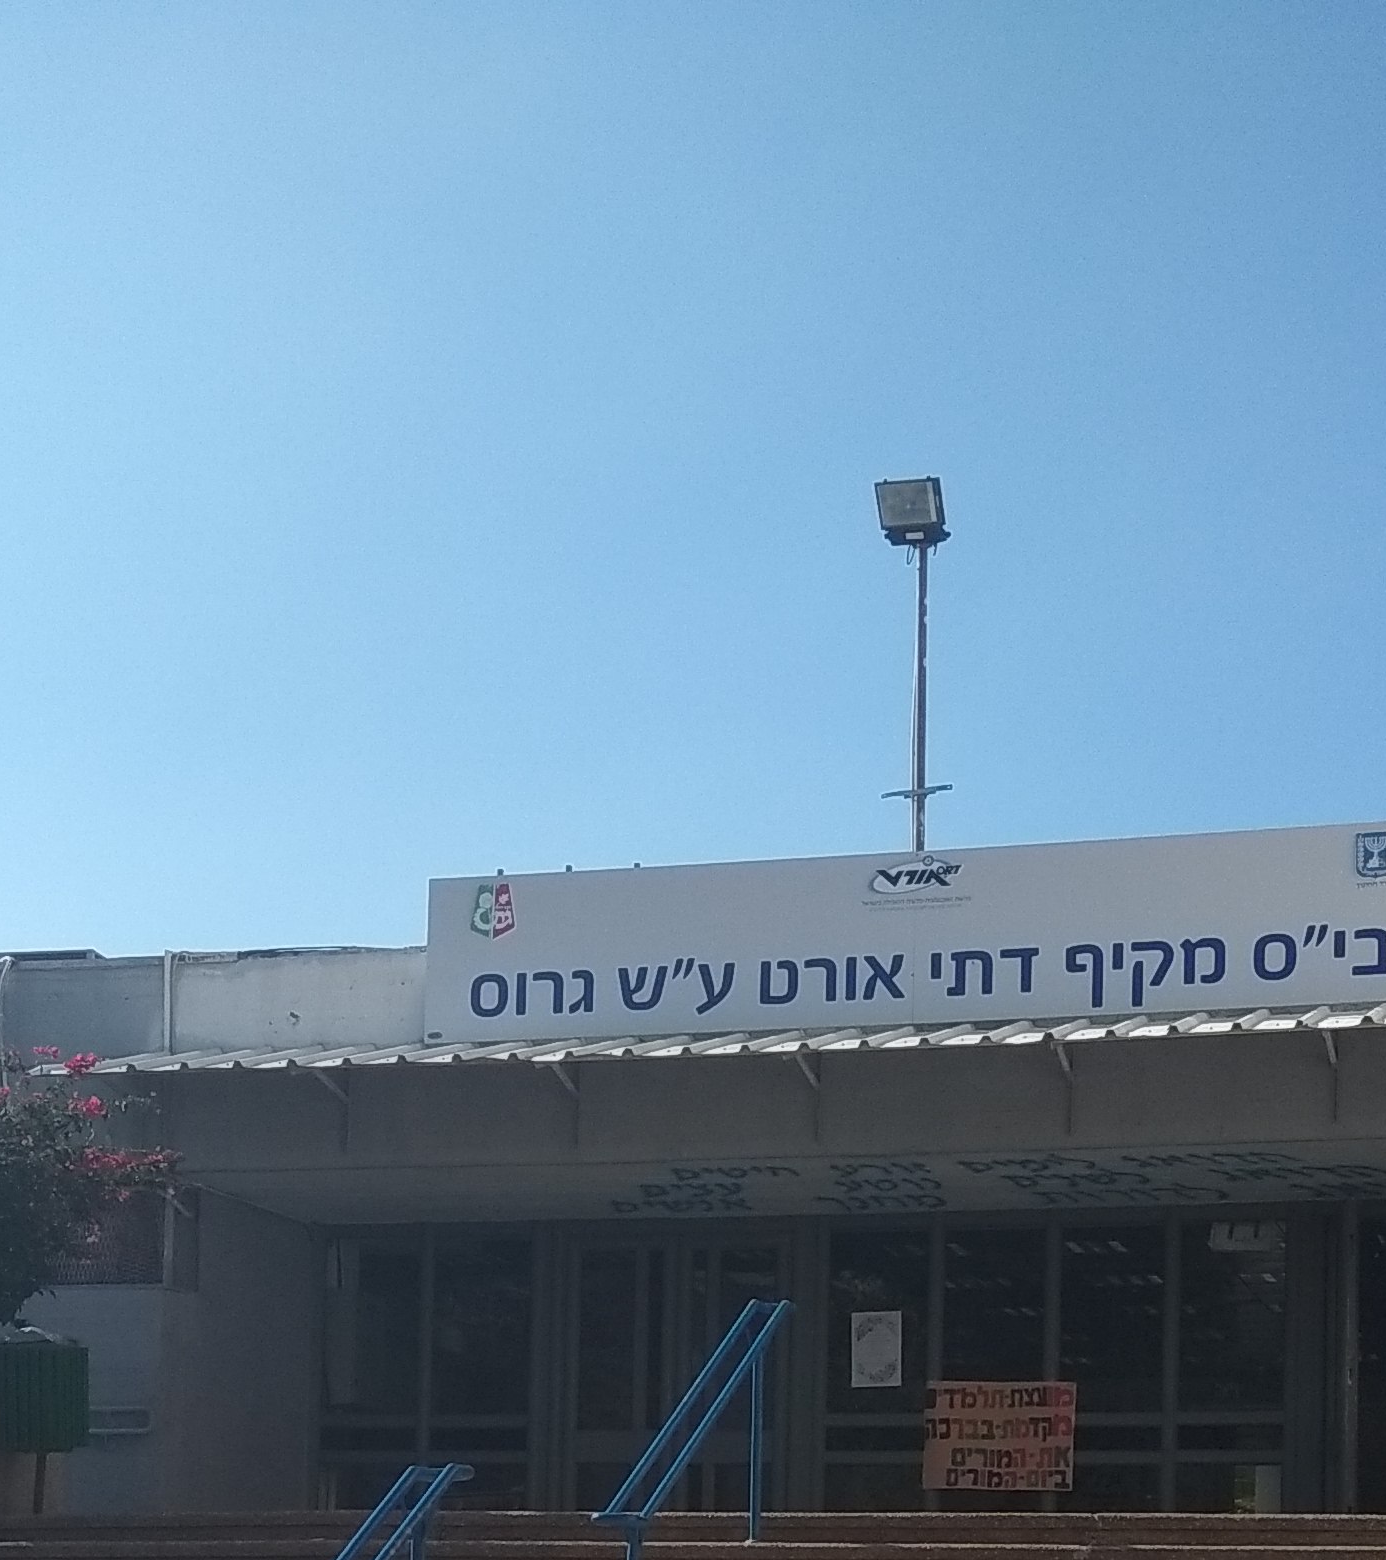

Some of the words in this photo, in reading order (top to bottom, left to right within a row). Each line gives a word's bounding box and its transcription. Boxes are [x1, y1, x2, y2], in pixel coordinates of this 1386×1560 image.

[936, 864, 961, 875] ORT
[760, 953, 906, 1005] אורט
[930, 947, 1040, 996] דתי
[1065, 937, 1226, 1008] מקיף
[471, 969, 595, 1018] גרוס
[617, 957, 736, 1015] ע"ש
[671, 1166, 800, 1181] חיטים
[830, 1162, 931, 1178] זורע
[640, 1182, 742, 1198] עצים
[835, 1177, 942, 1193] נוטע
[611, 1197, 753, 1213] אנשים
